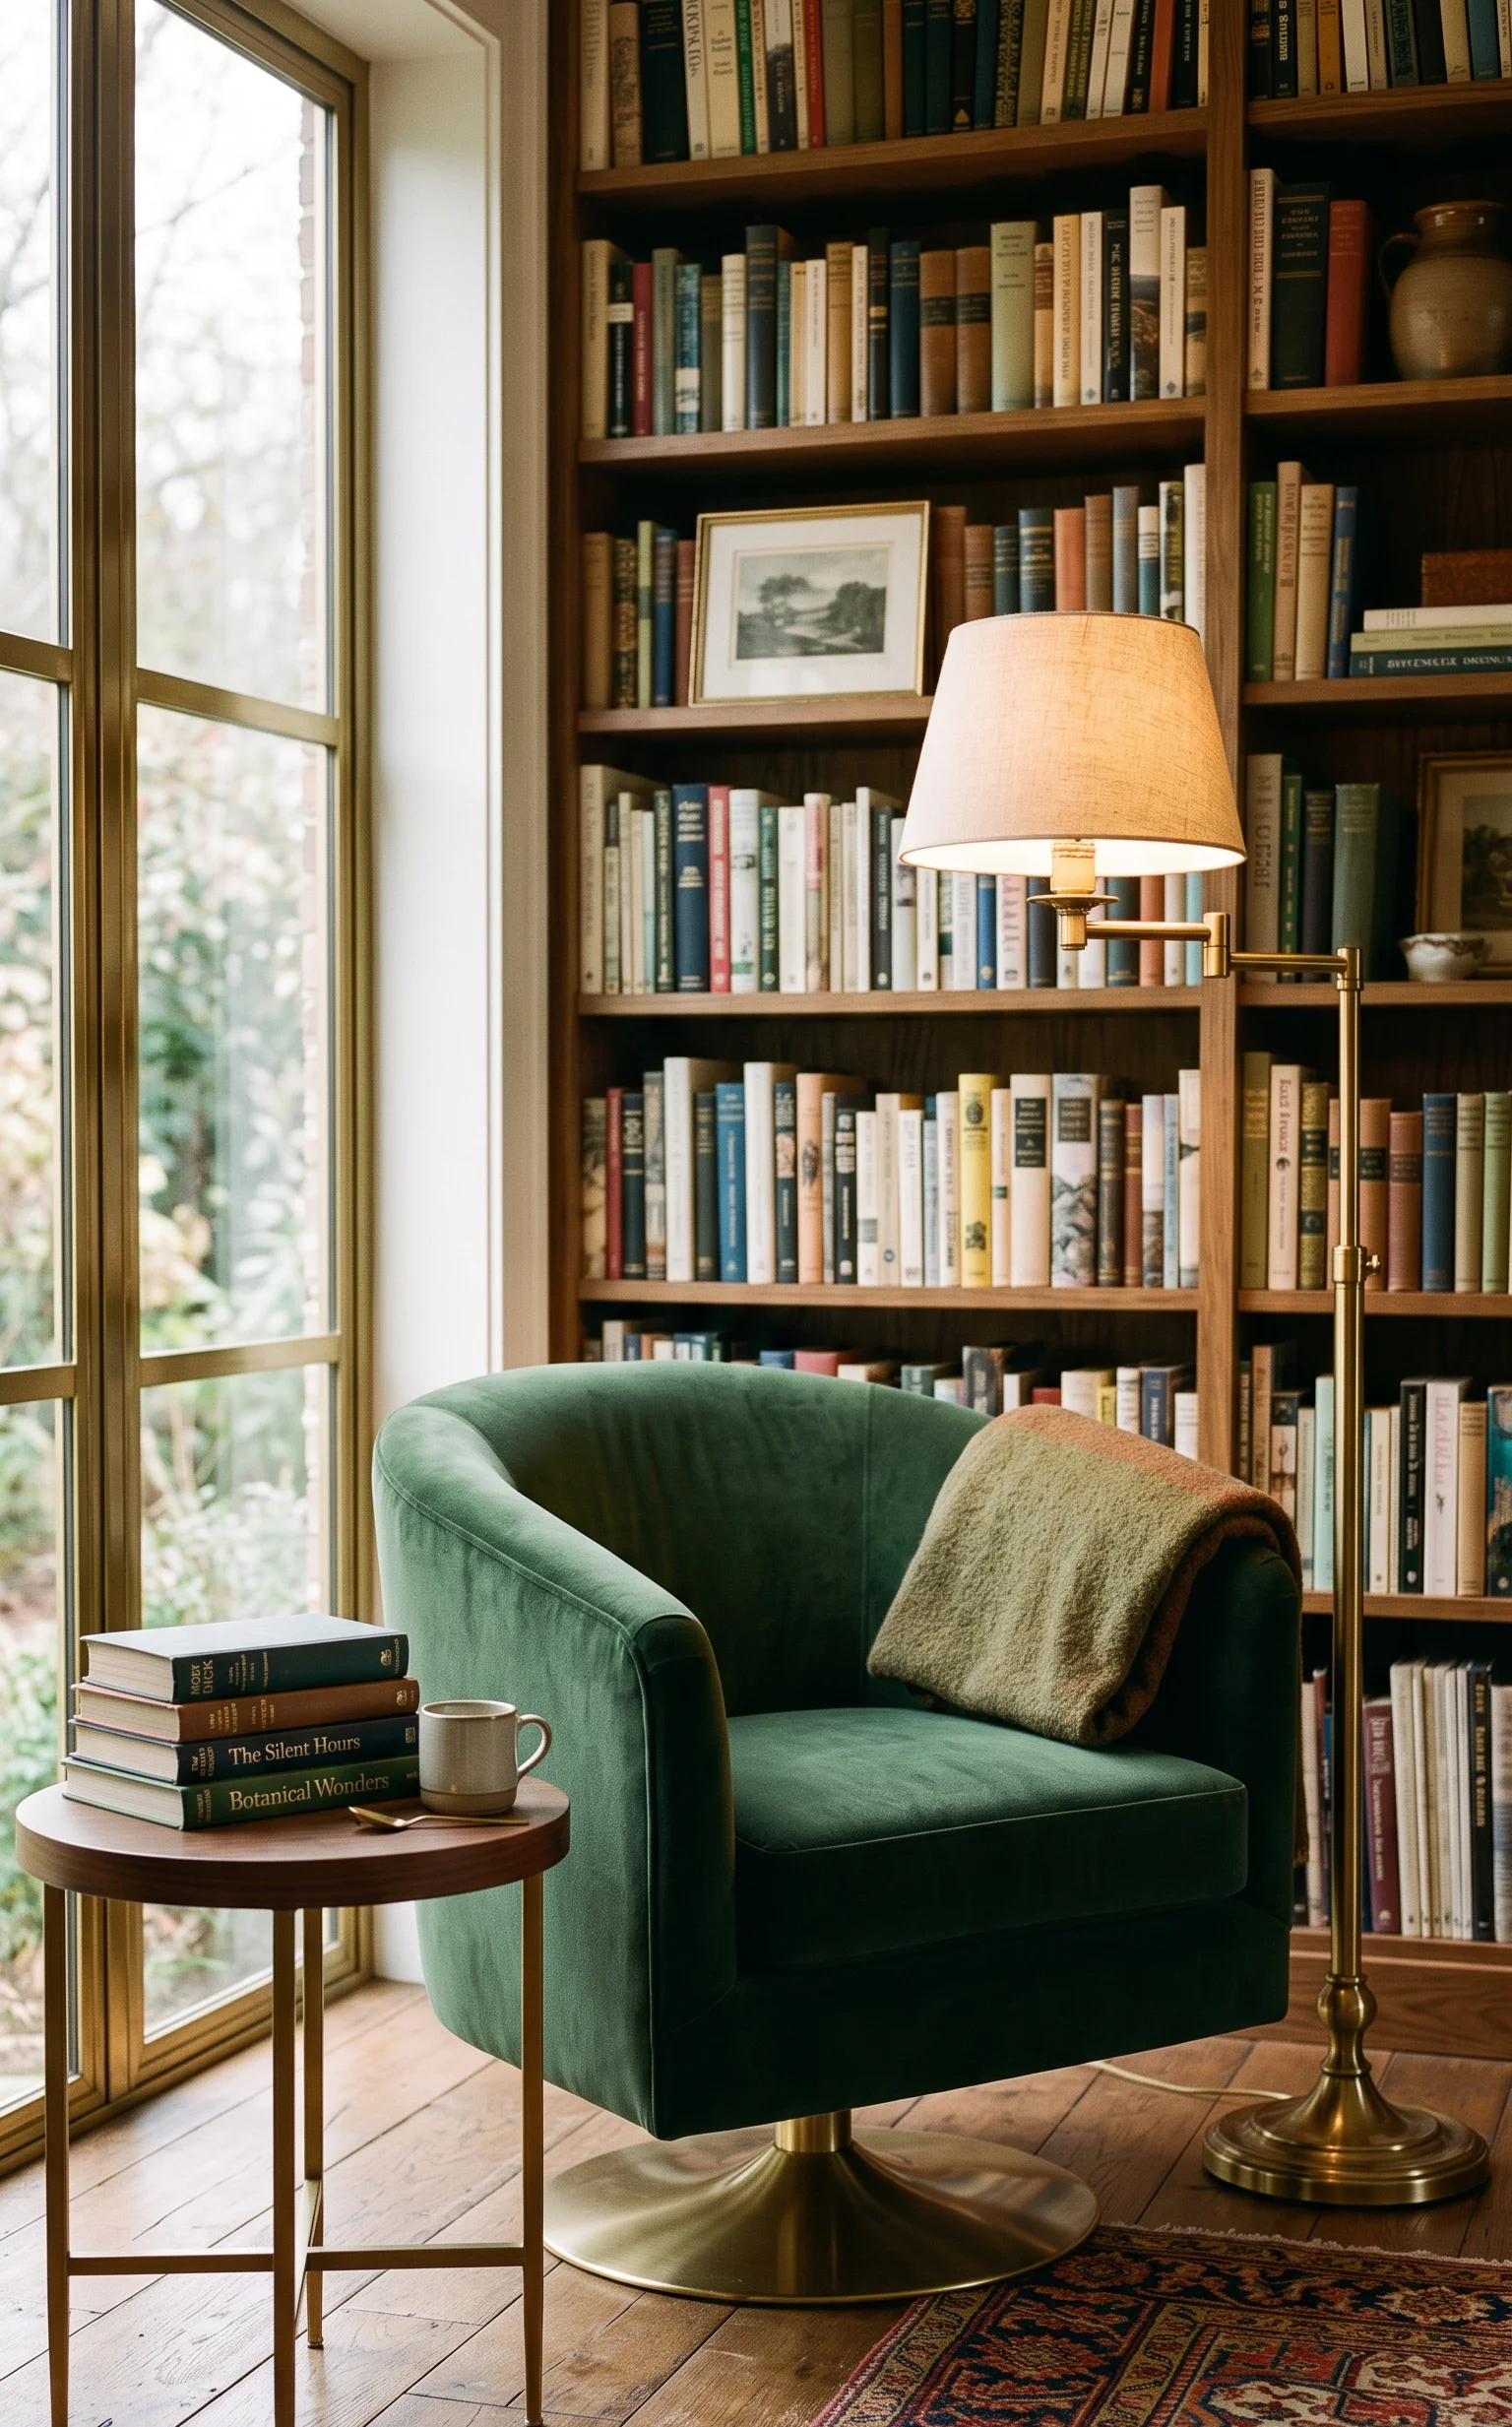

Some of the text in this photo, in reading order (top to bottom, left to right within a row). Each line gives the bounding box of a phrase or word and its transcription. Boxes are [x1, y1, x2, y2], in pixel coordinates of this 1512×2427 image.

[203, 1659, 214, 1694] DICK
[228, 1747, 261, 1765] The
[265, 1742, 310, 1761] Silent
[313, 1736, 361, 1755] Hours
[229, 1780, 312, 1811] Botanical
[314, 1773, 389, 1798] Wonders
